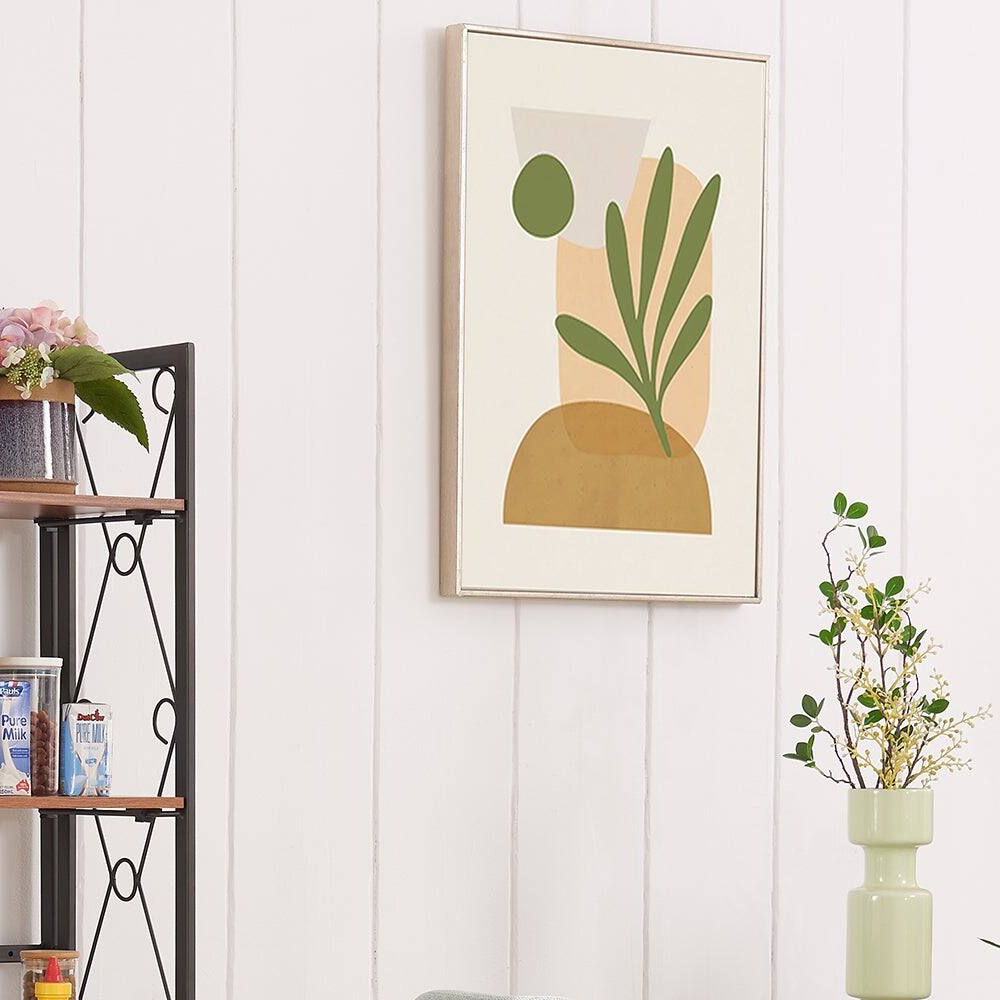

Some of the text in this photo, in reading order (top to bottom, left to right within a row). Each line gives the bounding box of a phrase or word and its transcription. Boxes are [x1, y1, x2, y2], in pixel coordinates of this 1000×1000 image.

[0, 687, 20, 696] Pauls
[1, 714, 27, 727] Pure
[2, 727, 27, 740] Milk
[76, 723, 105, 743] PURE MILK
